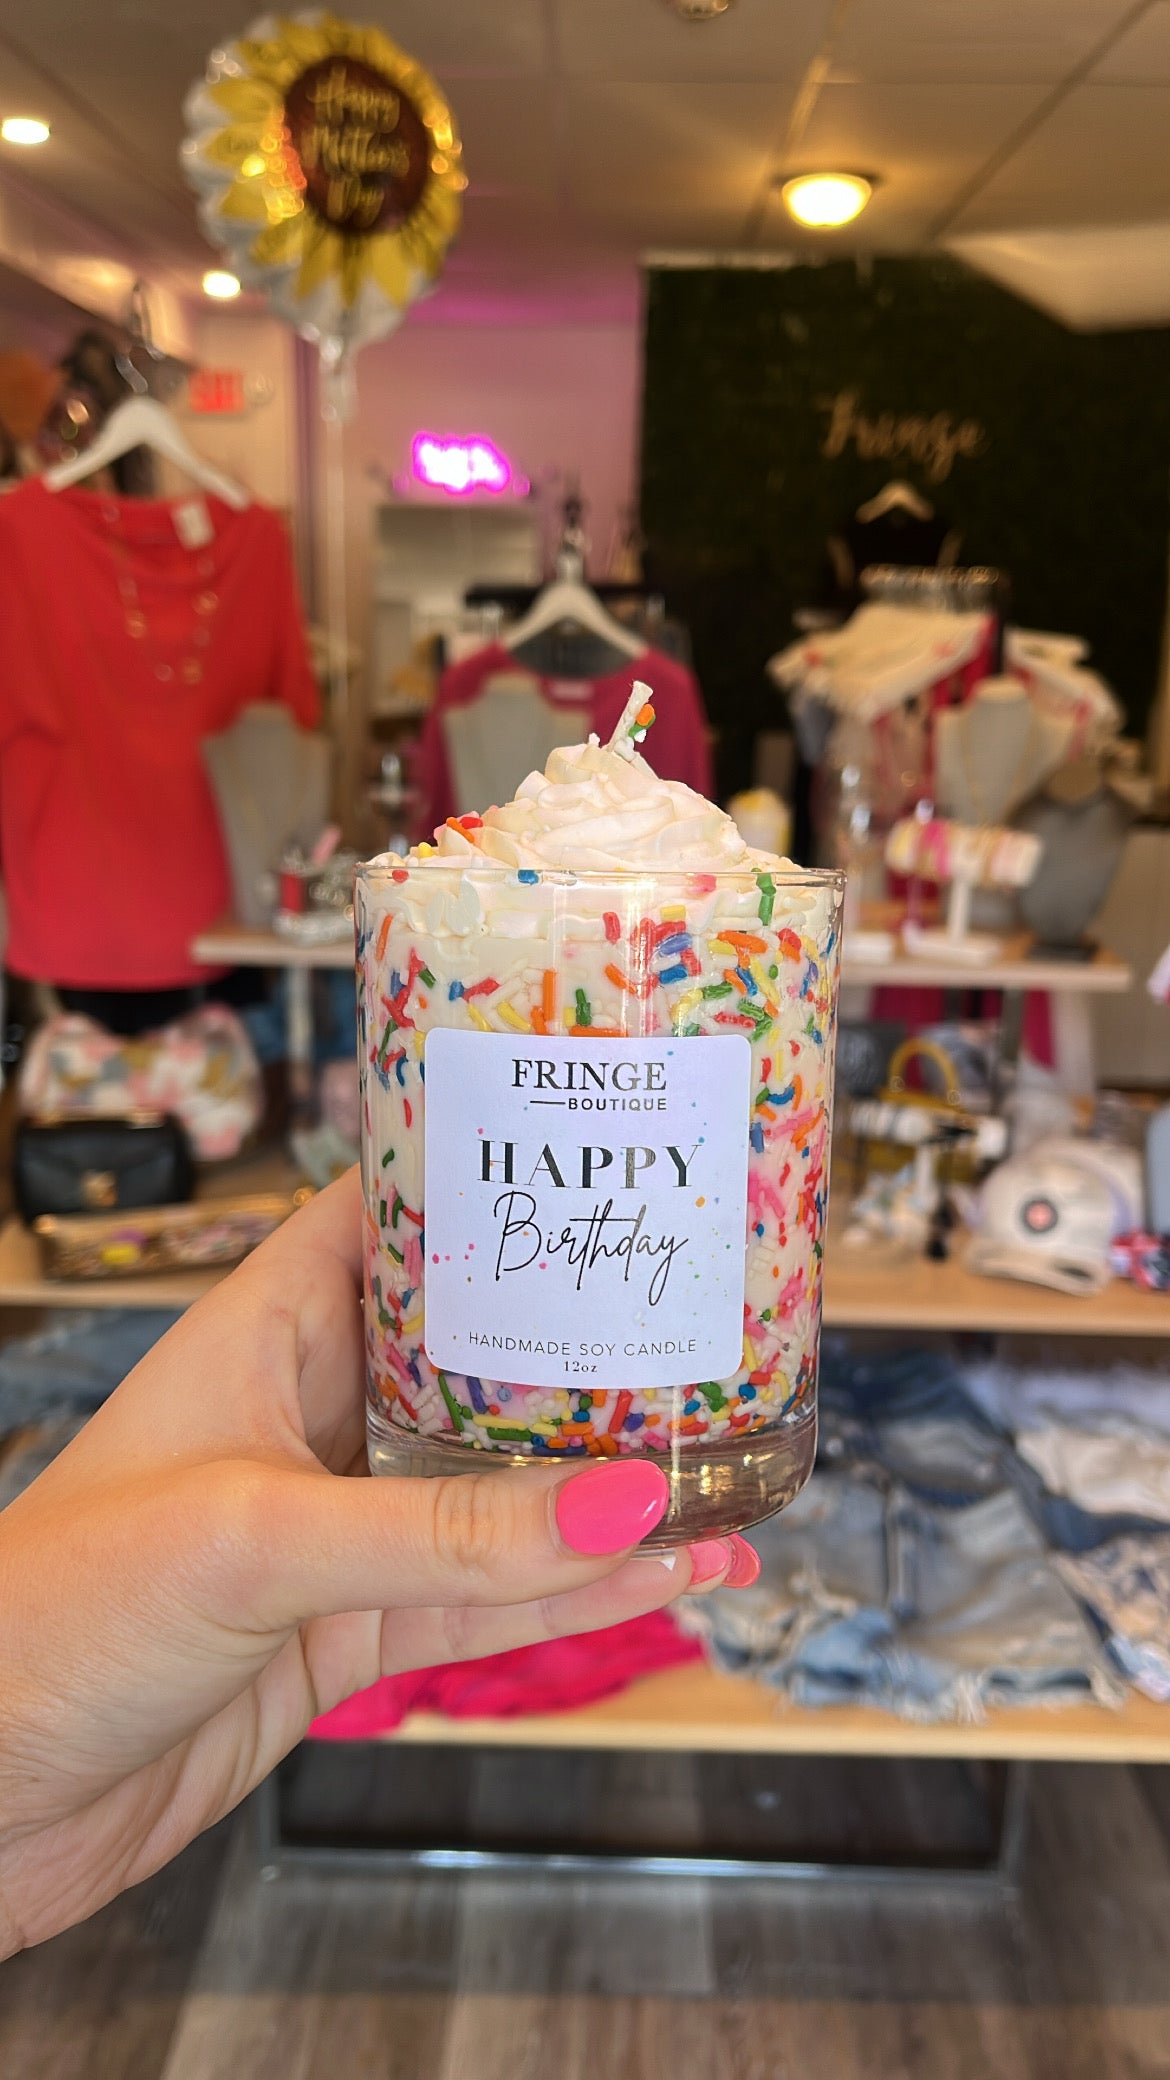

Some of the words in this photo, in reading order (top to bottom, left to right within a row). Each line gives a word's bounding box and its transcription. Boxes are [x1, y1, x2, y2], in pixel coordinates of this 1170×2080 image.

[511, 1058, 667, 1092] FRINGE
[568, 1097, 667, 1111] BOUTIQUE
[477, 1139, 703, 1189] HAPPY
[493, 1190, 689, 1306] Birthday
[468, 1331, 571, 1356] HANDMADE
[579, 1343, 616, 1357] SOY
[623, 1338, 697, 1357] CANDLE
[563, 1361, 598, 1374] 12oz
